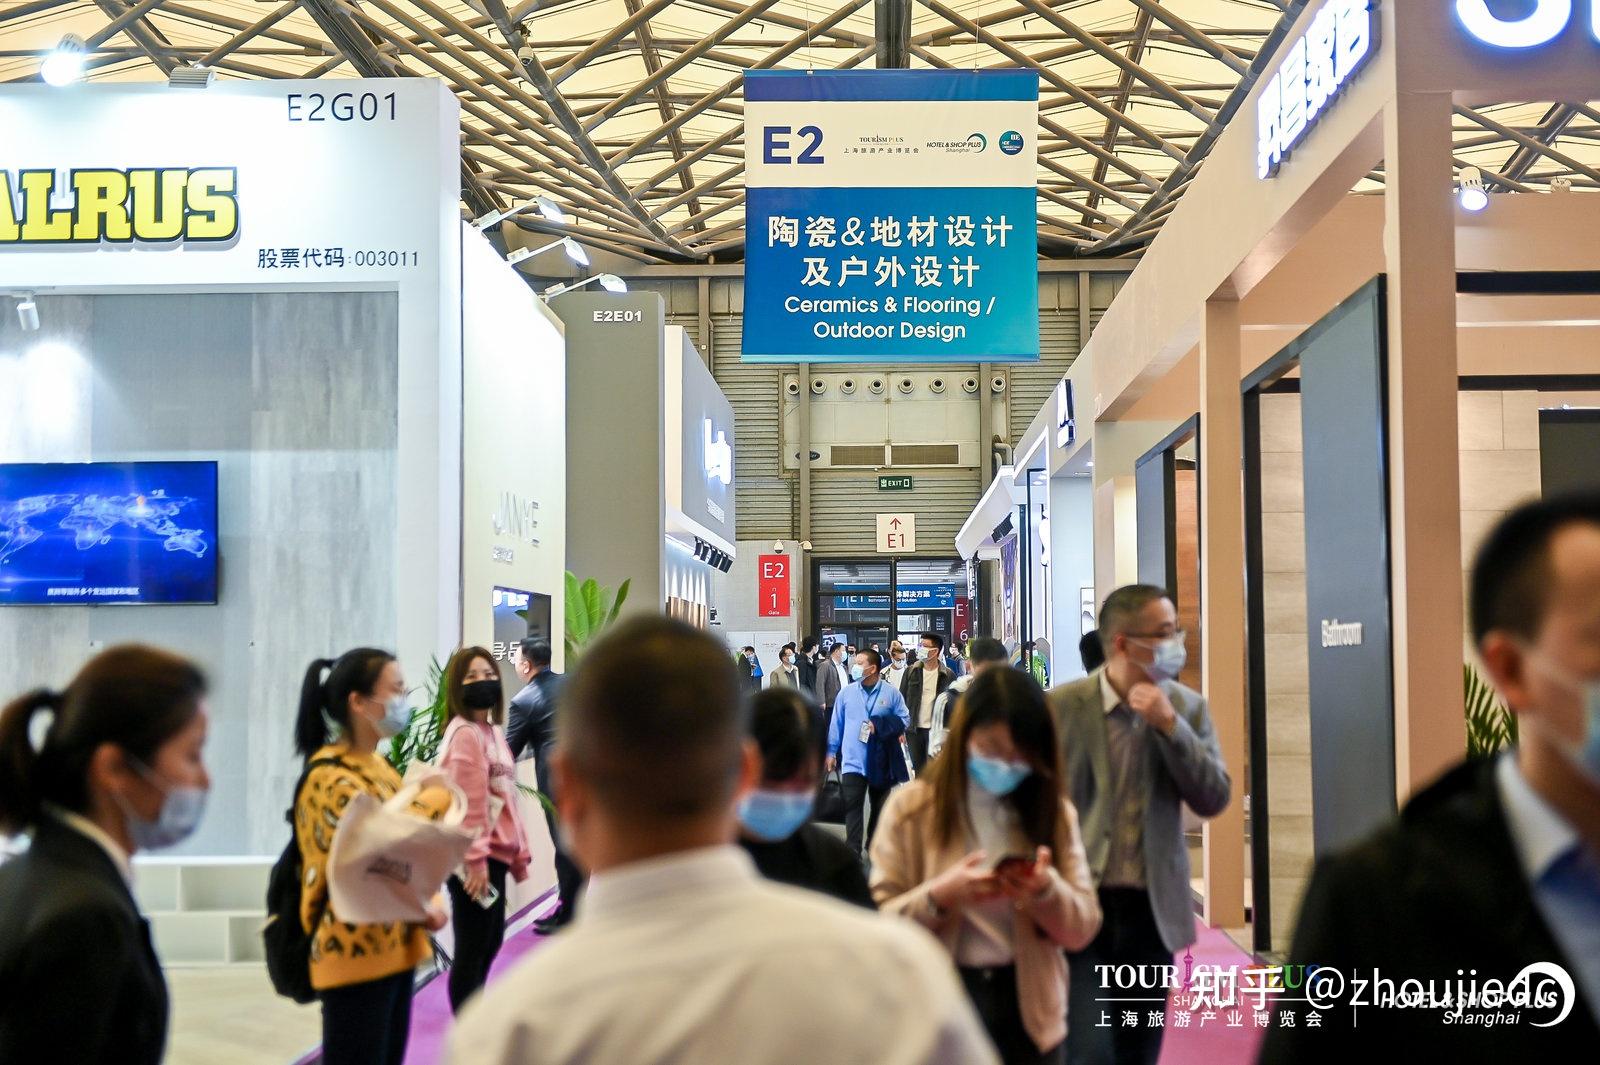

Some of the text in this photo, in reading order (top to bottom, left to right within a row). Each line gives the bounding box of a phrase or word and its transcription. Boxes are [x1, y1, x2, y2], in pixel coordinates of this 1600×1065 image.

[287, 92, 396, 121] E2G01
[763, 125, 825, 164] E2
[0, 167, 239, 243] LRUS
[768, 215, 1013, 248] 陶瓷&地材设计
[800, 255, 980, 288] 及户外设计
[593, 310, 642, 322] E2E01
[784, 296, 878, 313] Ceramics
[884, 296, 898, 313] &
[904, 296, 981, 317] Flooring
[813, 321, 966, 342] Outdoor Design
[887, 533, 905, 549] E1
[763, 562, 785, 578] E2
[770, 593, 777, 609] 1
[960, 629, 968, 641] 6
